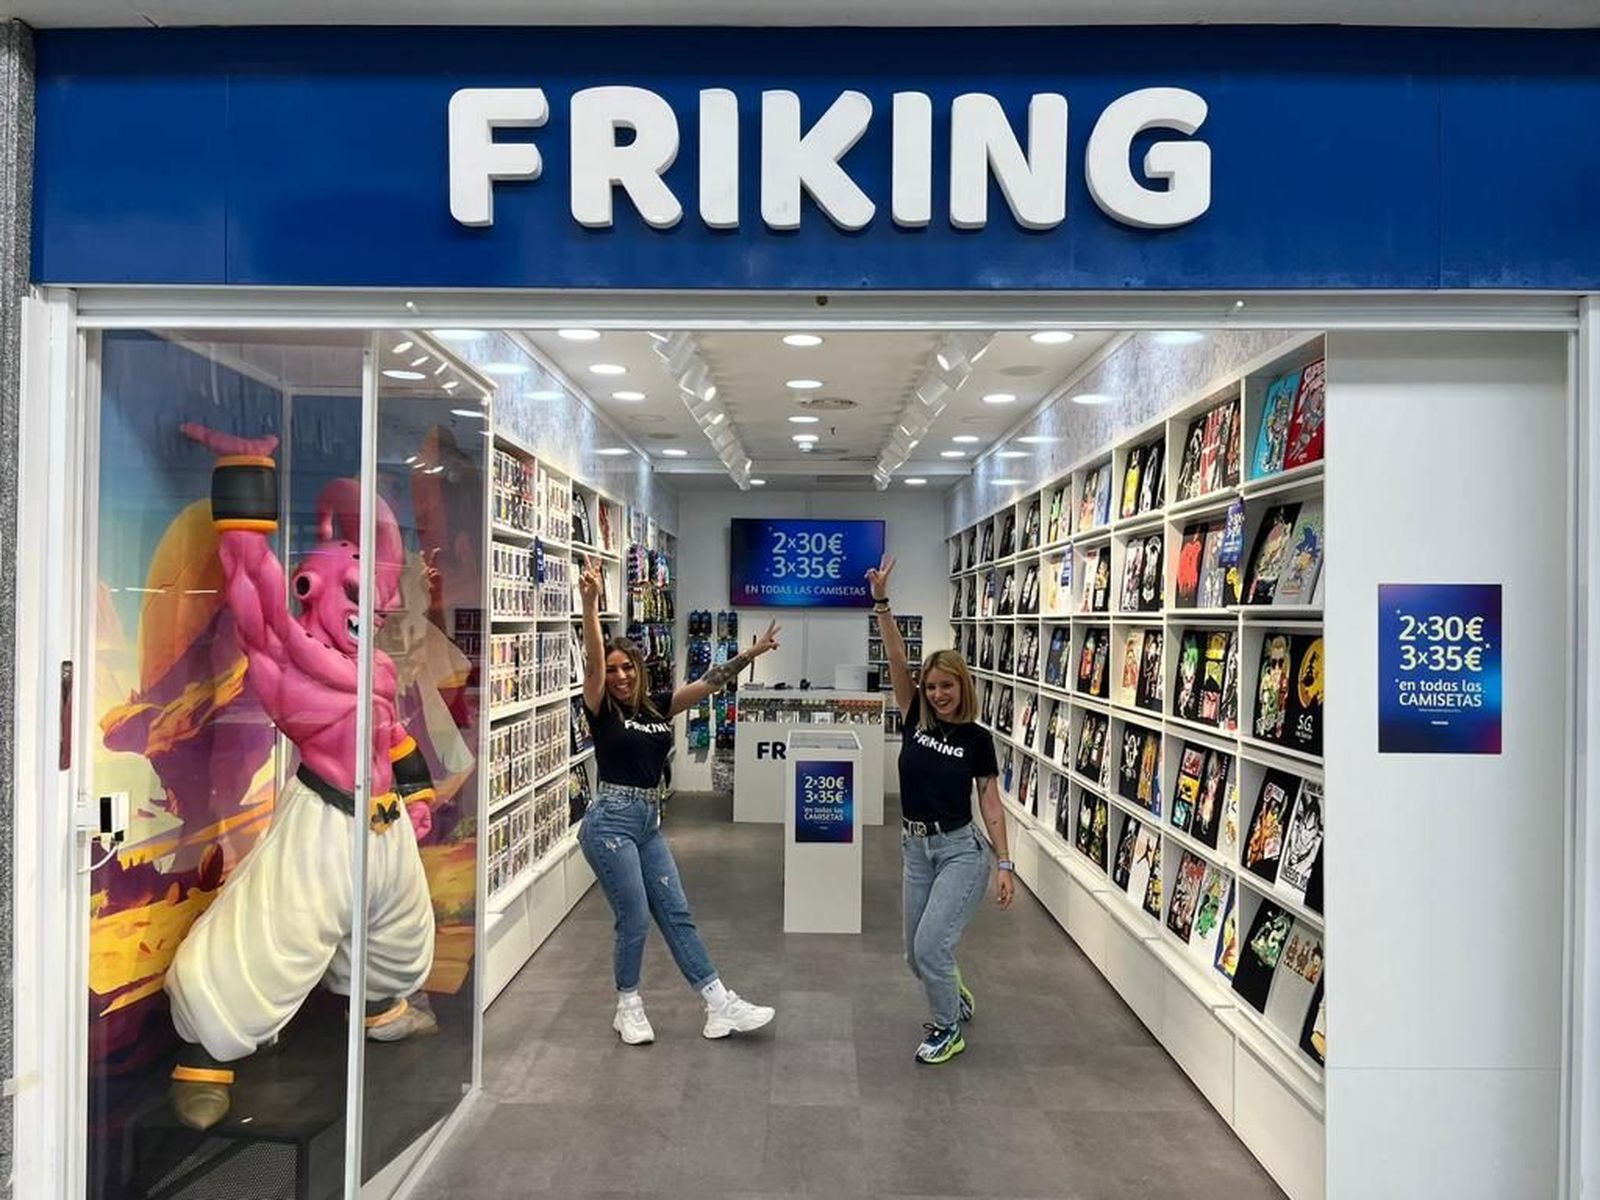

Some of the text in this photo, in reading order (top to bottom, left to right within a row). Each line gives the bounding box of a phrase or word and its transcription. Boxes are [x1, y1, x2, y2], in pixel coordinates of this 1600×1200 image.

[448, 86, 1211, 231] FRIKING
[745, 584, 867, 596] EN TODAS LAS CAMISETAS
[1399, 679, 1483, 692] en todas las
[1399, 692, 1483, 707] CAMISETAS
